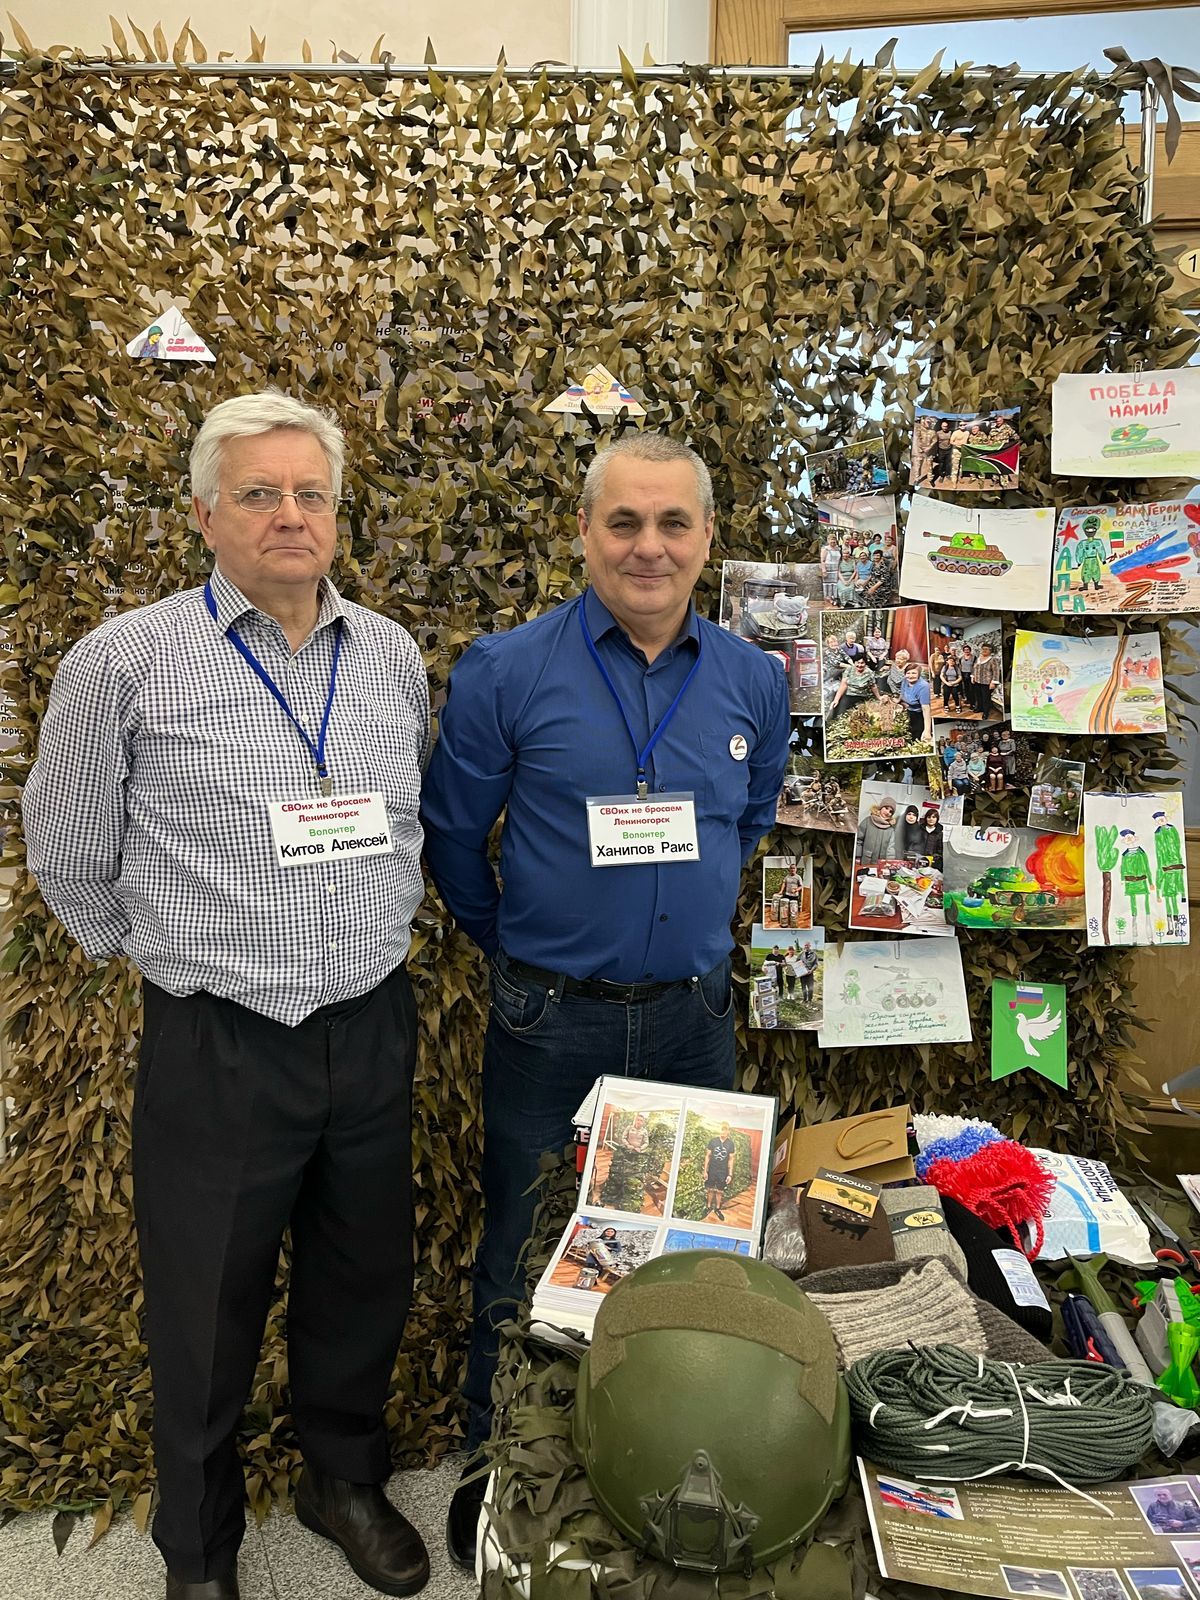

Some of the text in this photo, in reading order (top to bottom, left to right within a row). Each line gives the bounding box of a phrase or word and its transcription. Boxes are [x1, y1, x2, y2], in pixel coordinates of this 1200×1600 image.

[1090, 381, 1176, 400] ПОБЕДА
[1109, 397, 1169, 418] НАМИ!
[331, 797, 371, 808] бросаем
[298, 810, 360, 823] Лениногорск
[645, 805, 683, 815] бросаем
[614, 817, 671, 826] Лениногорск
[309, 825, 356, 837] Волонтер
[622, 831, 666, 840] Волонтер
[280, 832, 388, 858] Китов Алексей
[596, 841, 694, 858] Ханипов Раис
[1092, 1161, 1118, 1193] АЖНЫЕ
